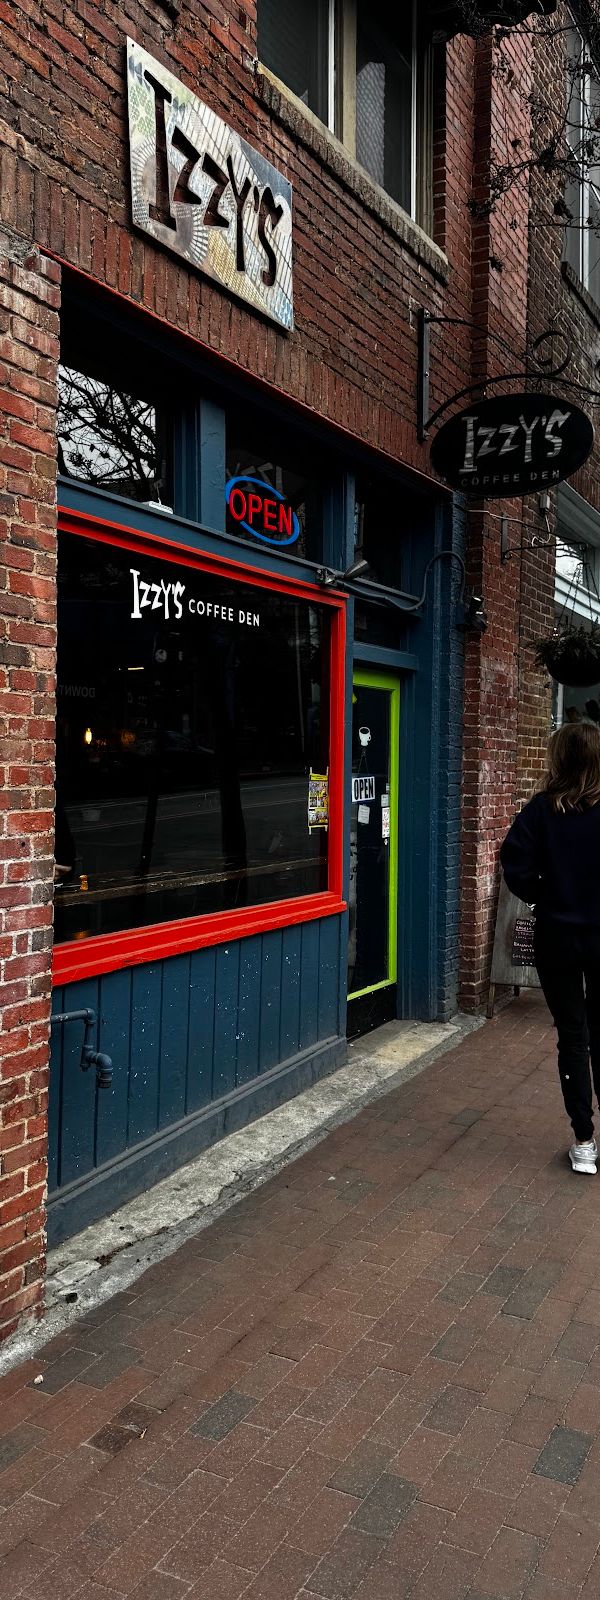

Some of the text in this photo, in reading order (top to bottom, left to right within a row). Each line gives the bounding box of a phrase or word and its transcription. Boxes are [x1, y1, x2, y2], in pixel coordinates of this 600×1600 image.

[461, 473, 520, 487] COFFEE
[530, 469, 560, 481] DEN
[229, 488, 292, 537] OPEN
[188, 598, 234, 622] COFFEE
[238, 610, 260, 627] DEN
[354, 778, 374, 800] OPEN
